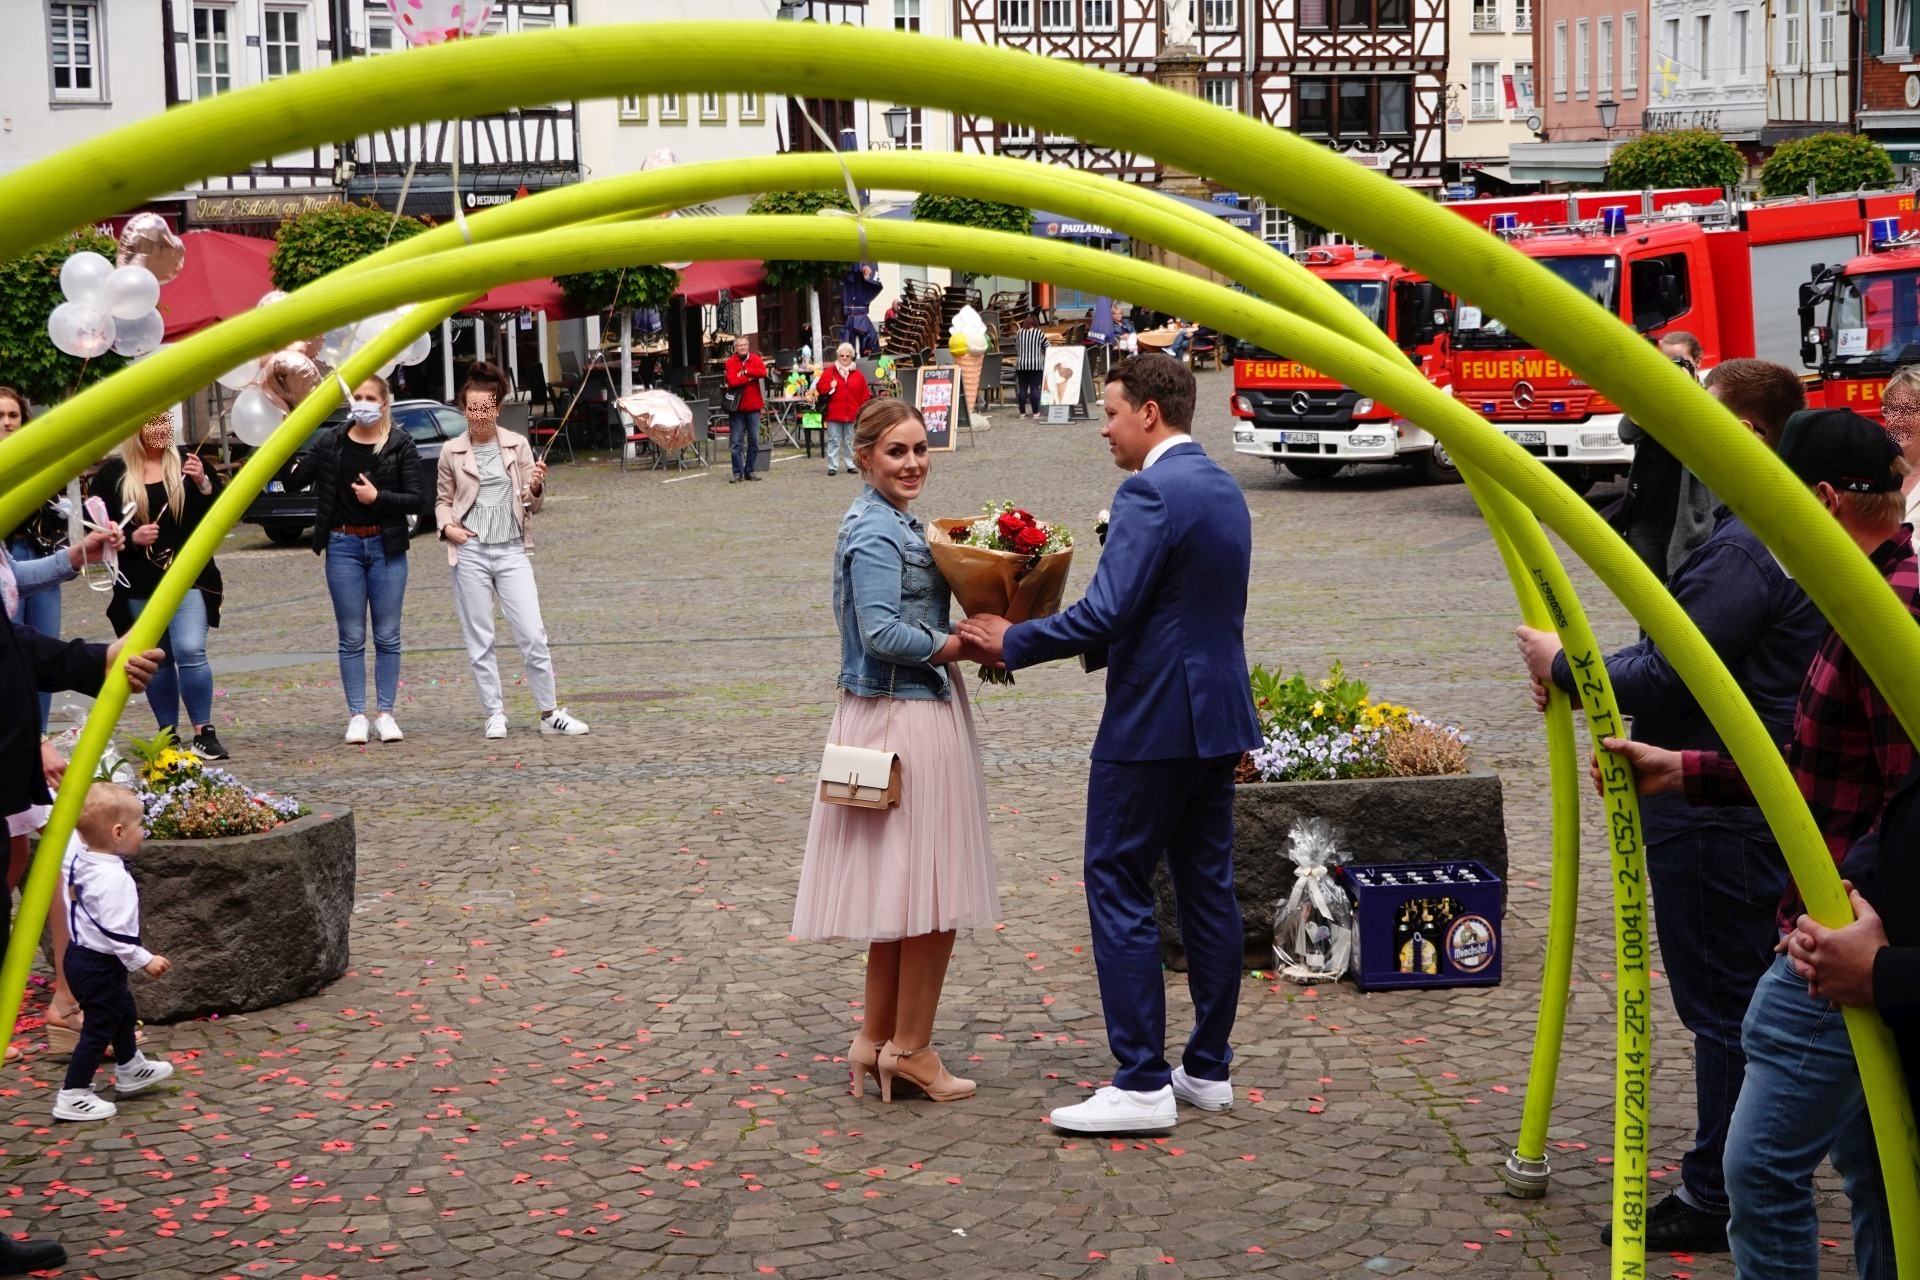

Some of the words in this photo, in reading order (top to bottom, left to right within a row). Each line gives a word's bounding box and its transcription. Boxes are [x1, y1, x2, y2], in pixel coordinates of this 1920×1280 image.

[1647, 111, 1682, 132] MARKT
[229, 198, 279, 217] Eisdiele
[476, 195, 511, 205] RESTAURANT
[1245, 363, 1329, 379] FEUERW
[1622, 989, 1645, 1245] 14811-10/2014-ZPC
[1622, 1261, 1642, 1280] N
